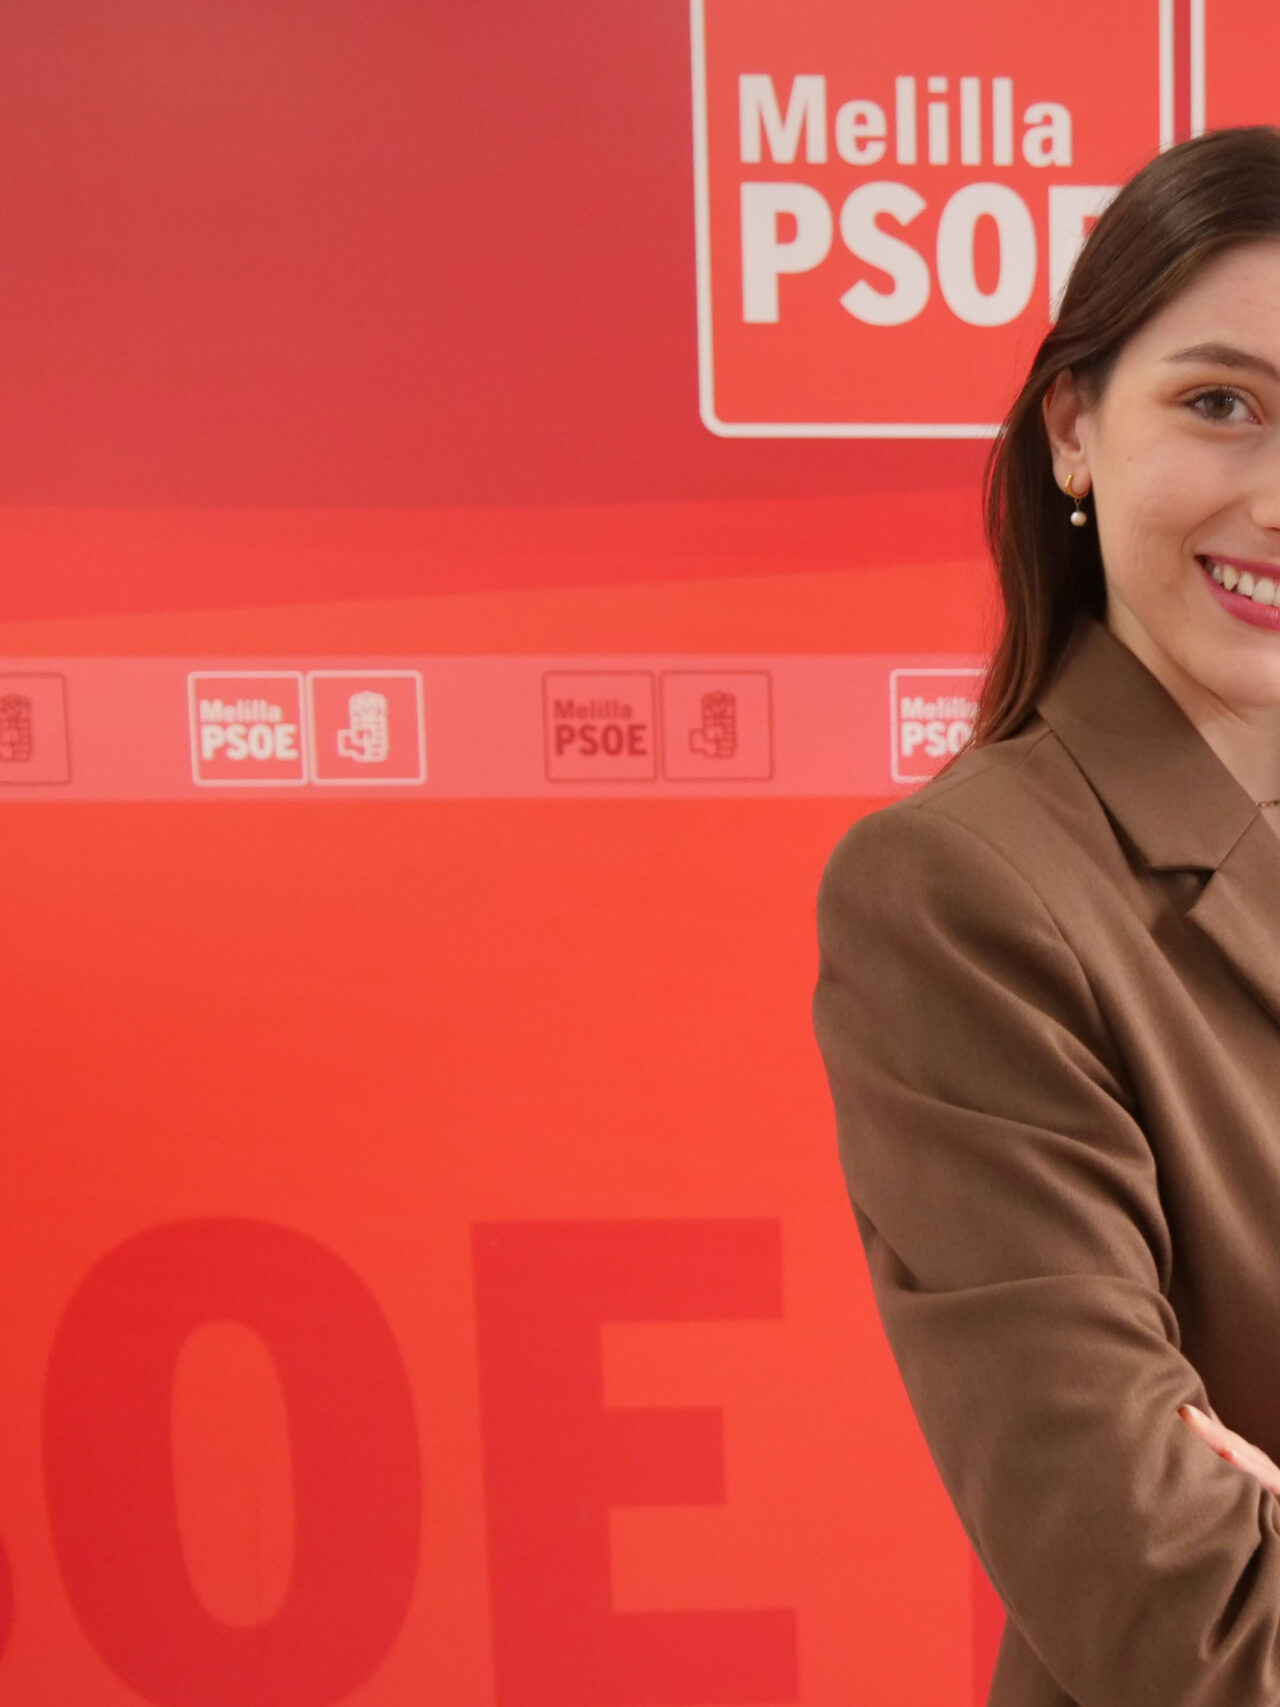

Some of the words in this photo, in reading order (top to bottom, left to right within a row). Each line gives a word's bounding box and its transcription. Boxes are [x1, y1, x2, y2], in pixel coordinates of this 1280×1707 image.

[738, 73, 1073, 168] Melilla
[199, 699, 282, 722] Melilla
[553, 699, 634, 721] Melilla
[201, 724, 298, 760] PSOE
[554, 724, 647, 756] PSOE
[0, 1216, 800, 1707] OE
